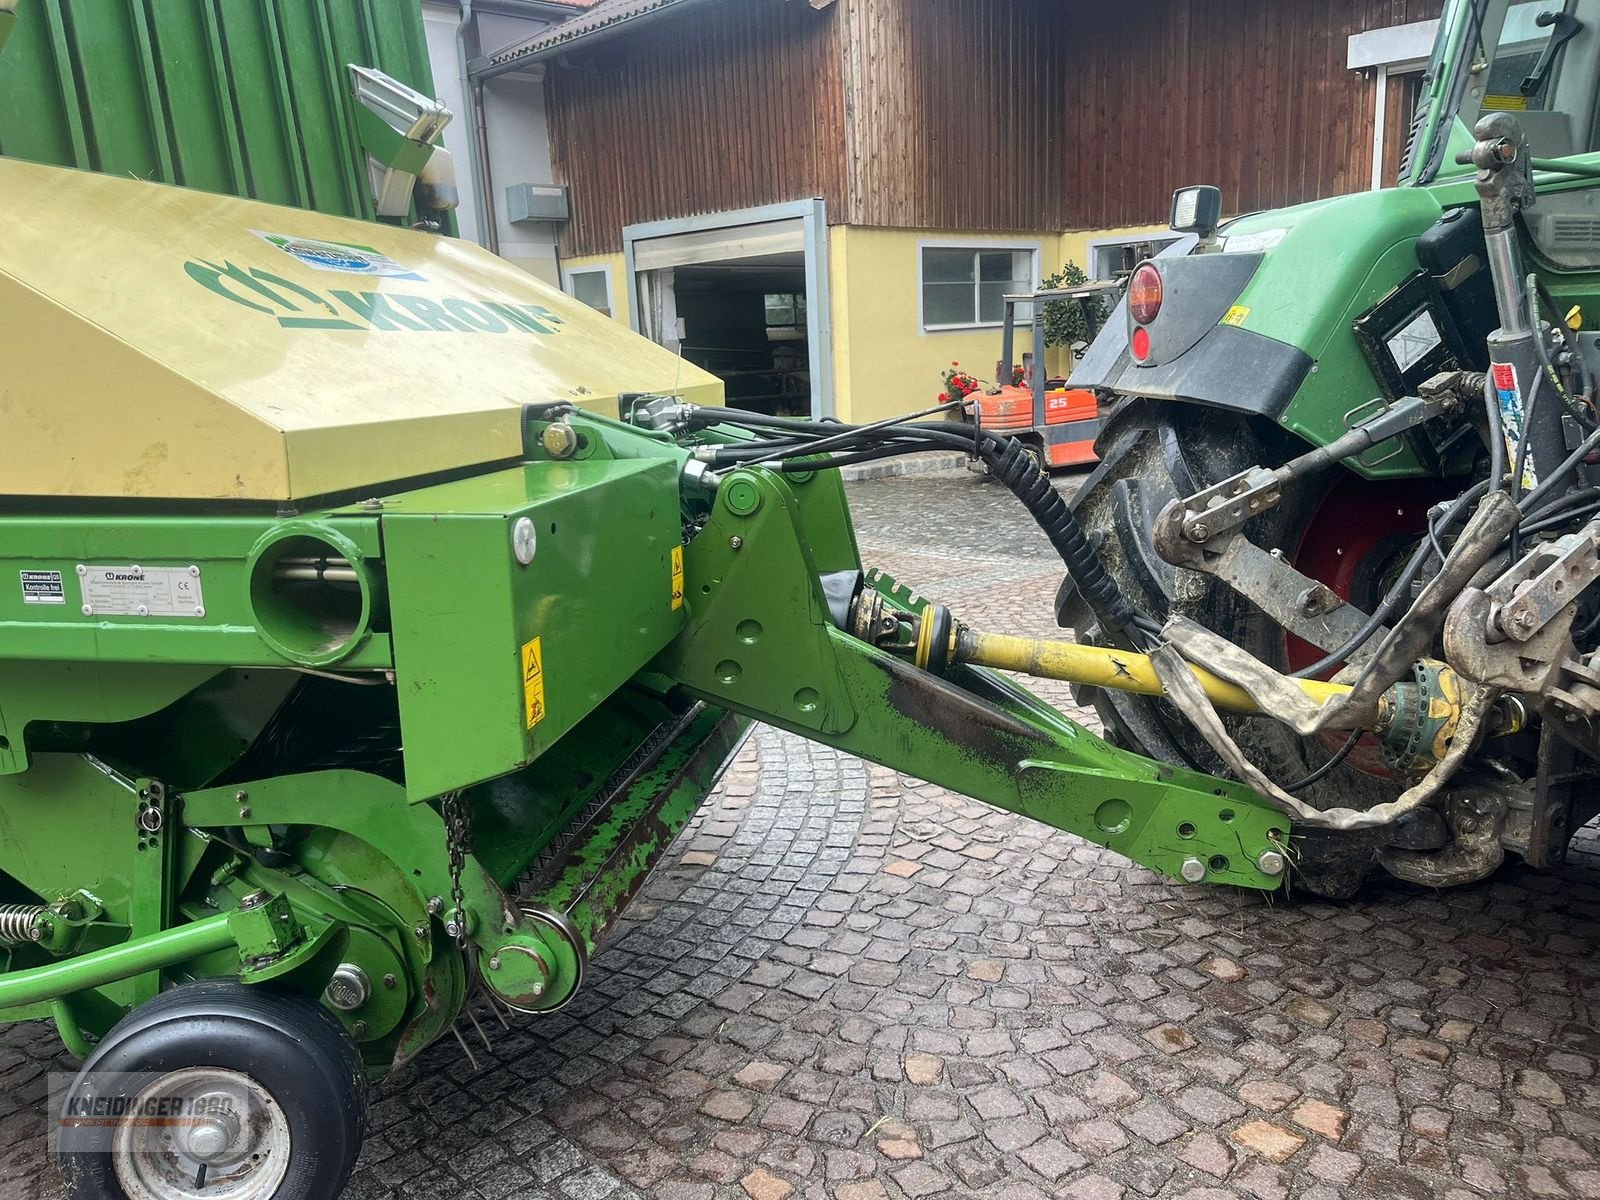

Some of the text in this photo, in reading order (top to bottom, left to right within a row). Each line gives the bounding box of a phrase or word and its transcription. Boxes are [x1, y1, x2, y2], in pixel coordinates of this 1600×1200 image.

[1049, 397, 1067, 409] 25
[115, 573, 146, 581] KRONE
[25, 583, 50, 591] Kontrolle
[178, 582, 190, 590] CE
